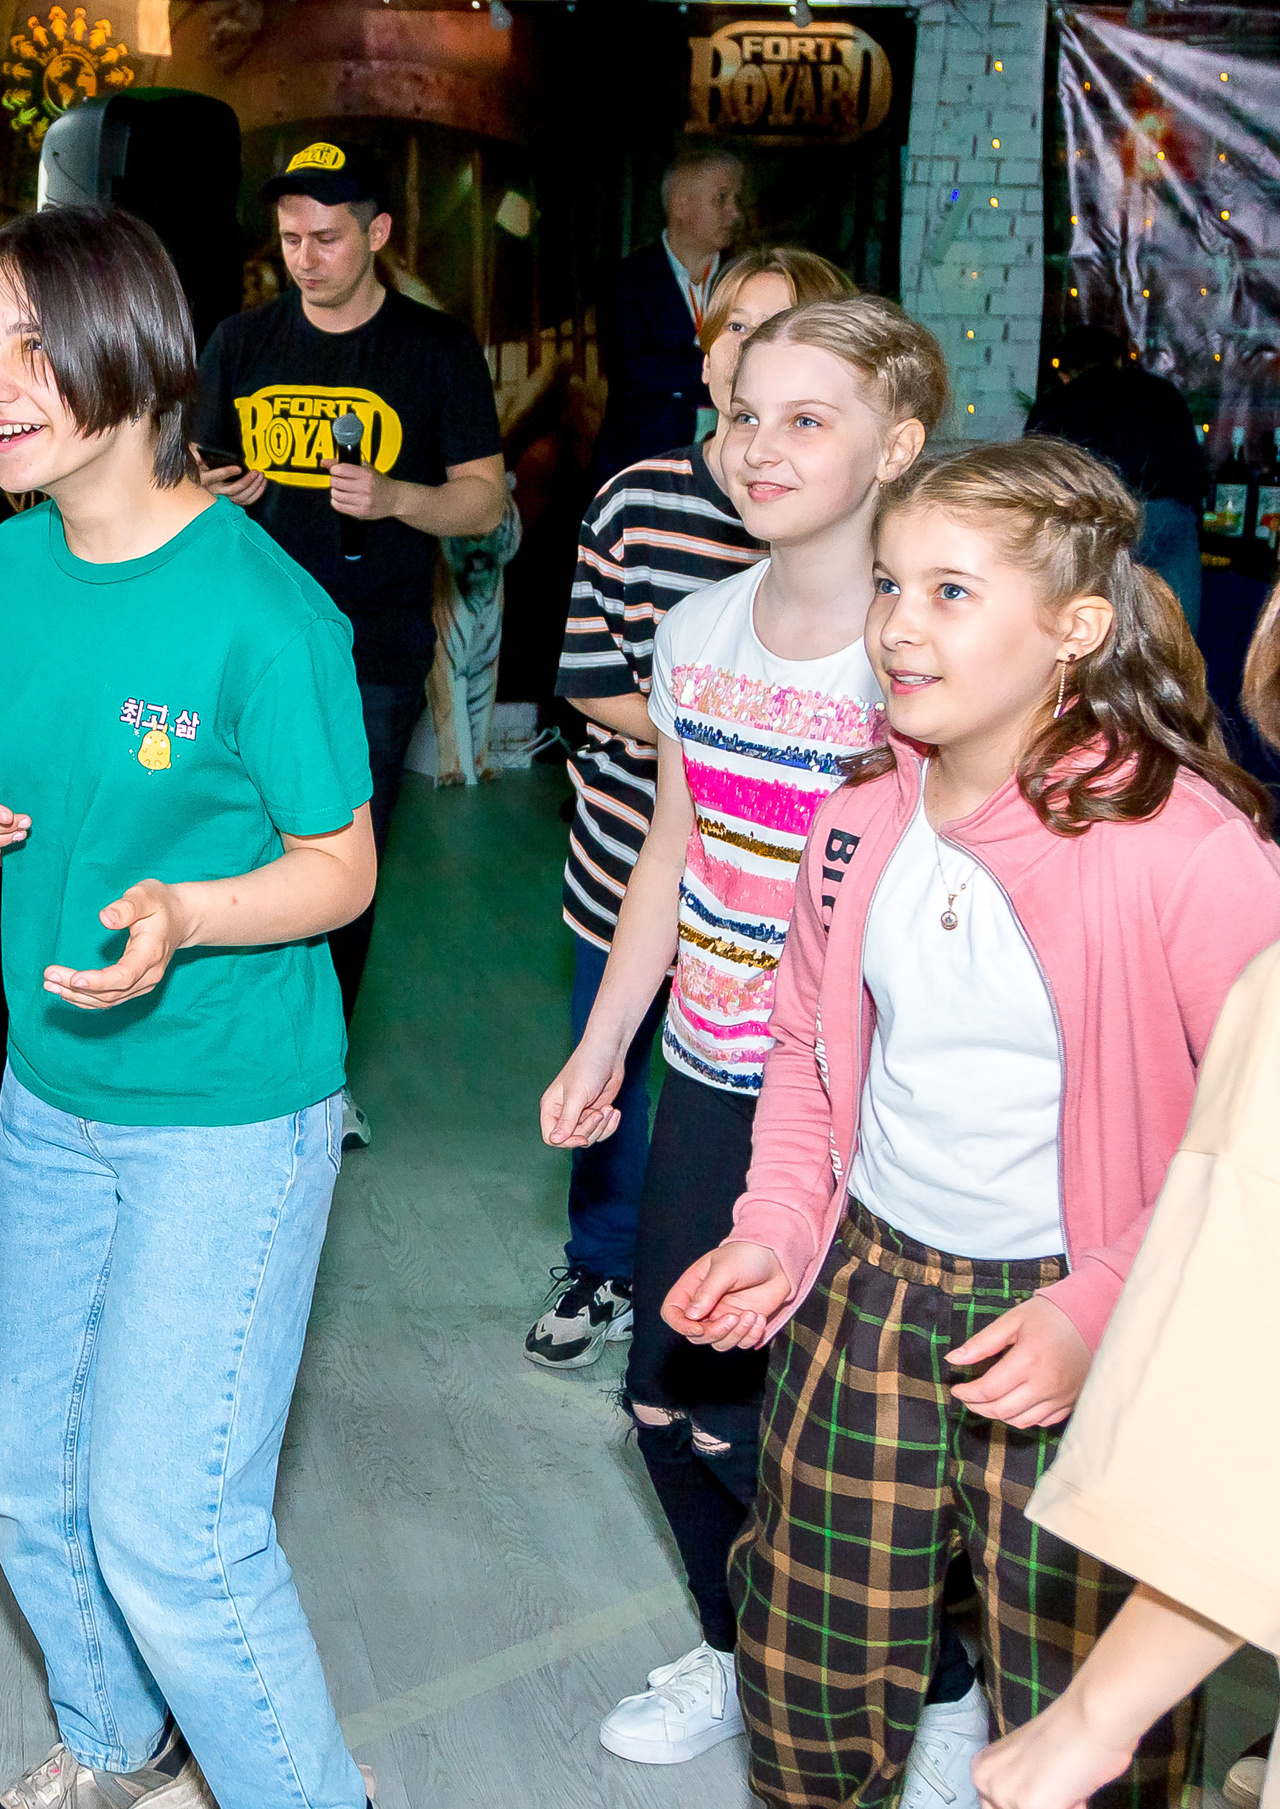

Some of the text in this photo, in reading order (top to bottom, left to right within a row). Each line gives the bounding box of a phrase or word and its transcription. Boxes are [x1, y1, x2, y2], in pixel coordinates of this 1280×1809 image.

[741, 35, 838, 62] FORT
[683, 34, 894, 134] BOYARD
[273, 397, 354, 418] FORT
[234, 394, 403, 474] BOYAD
[120, 697, 169, 732] 최고
